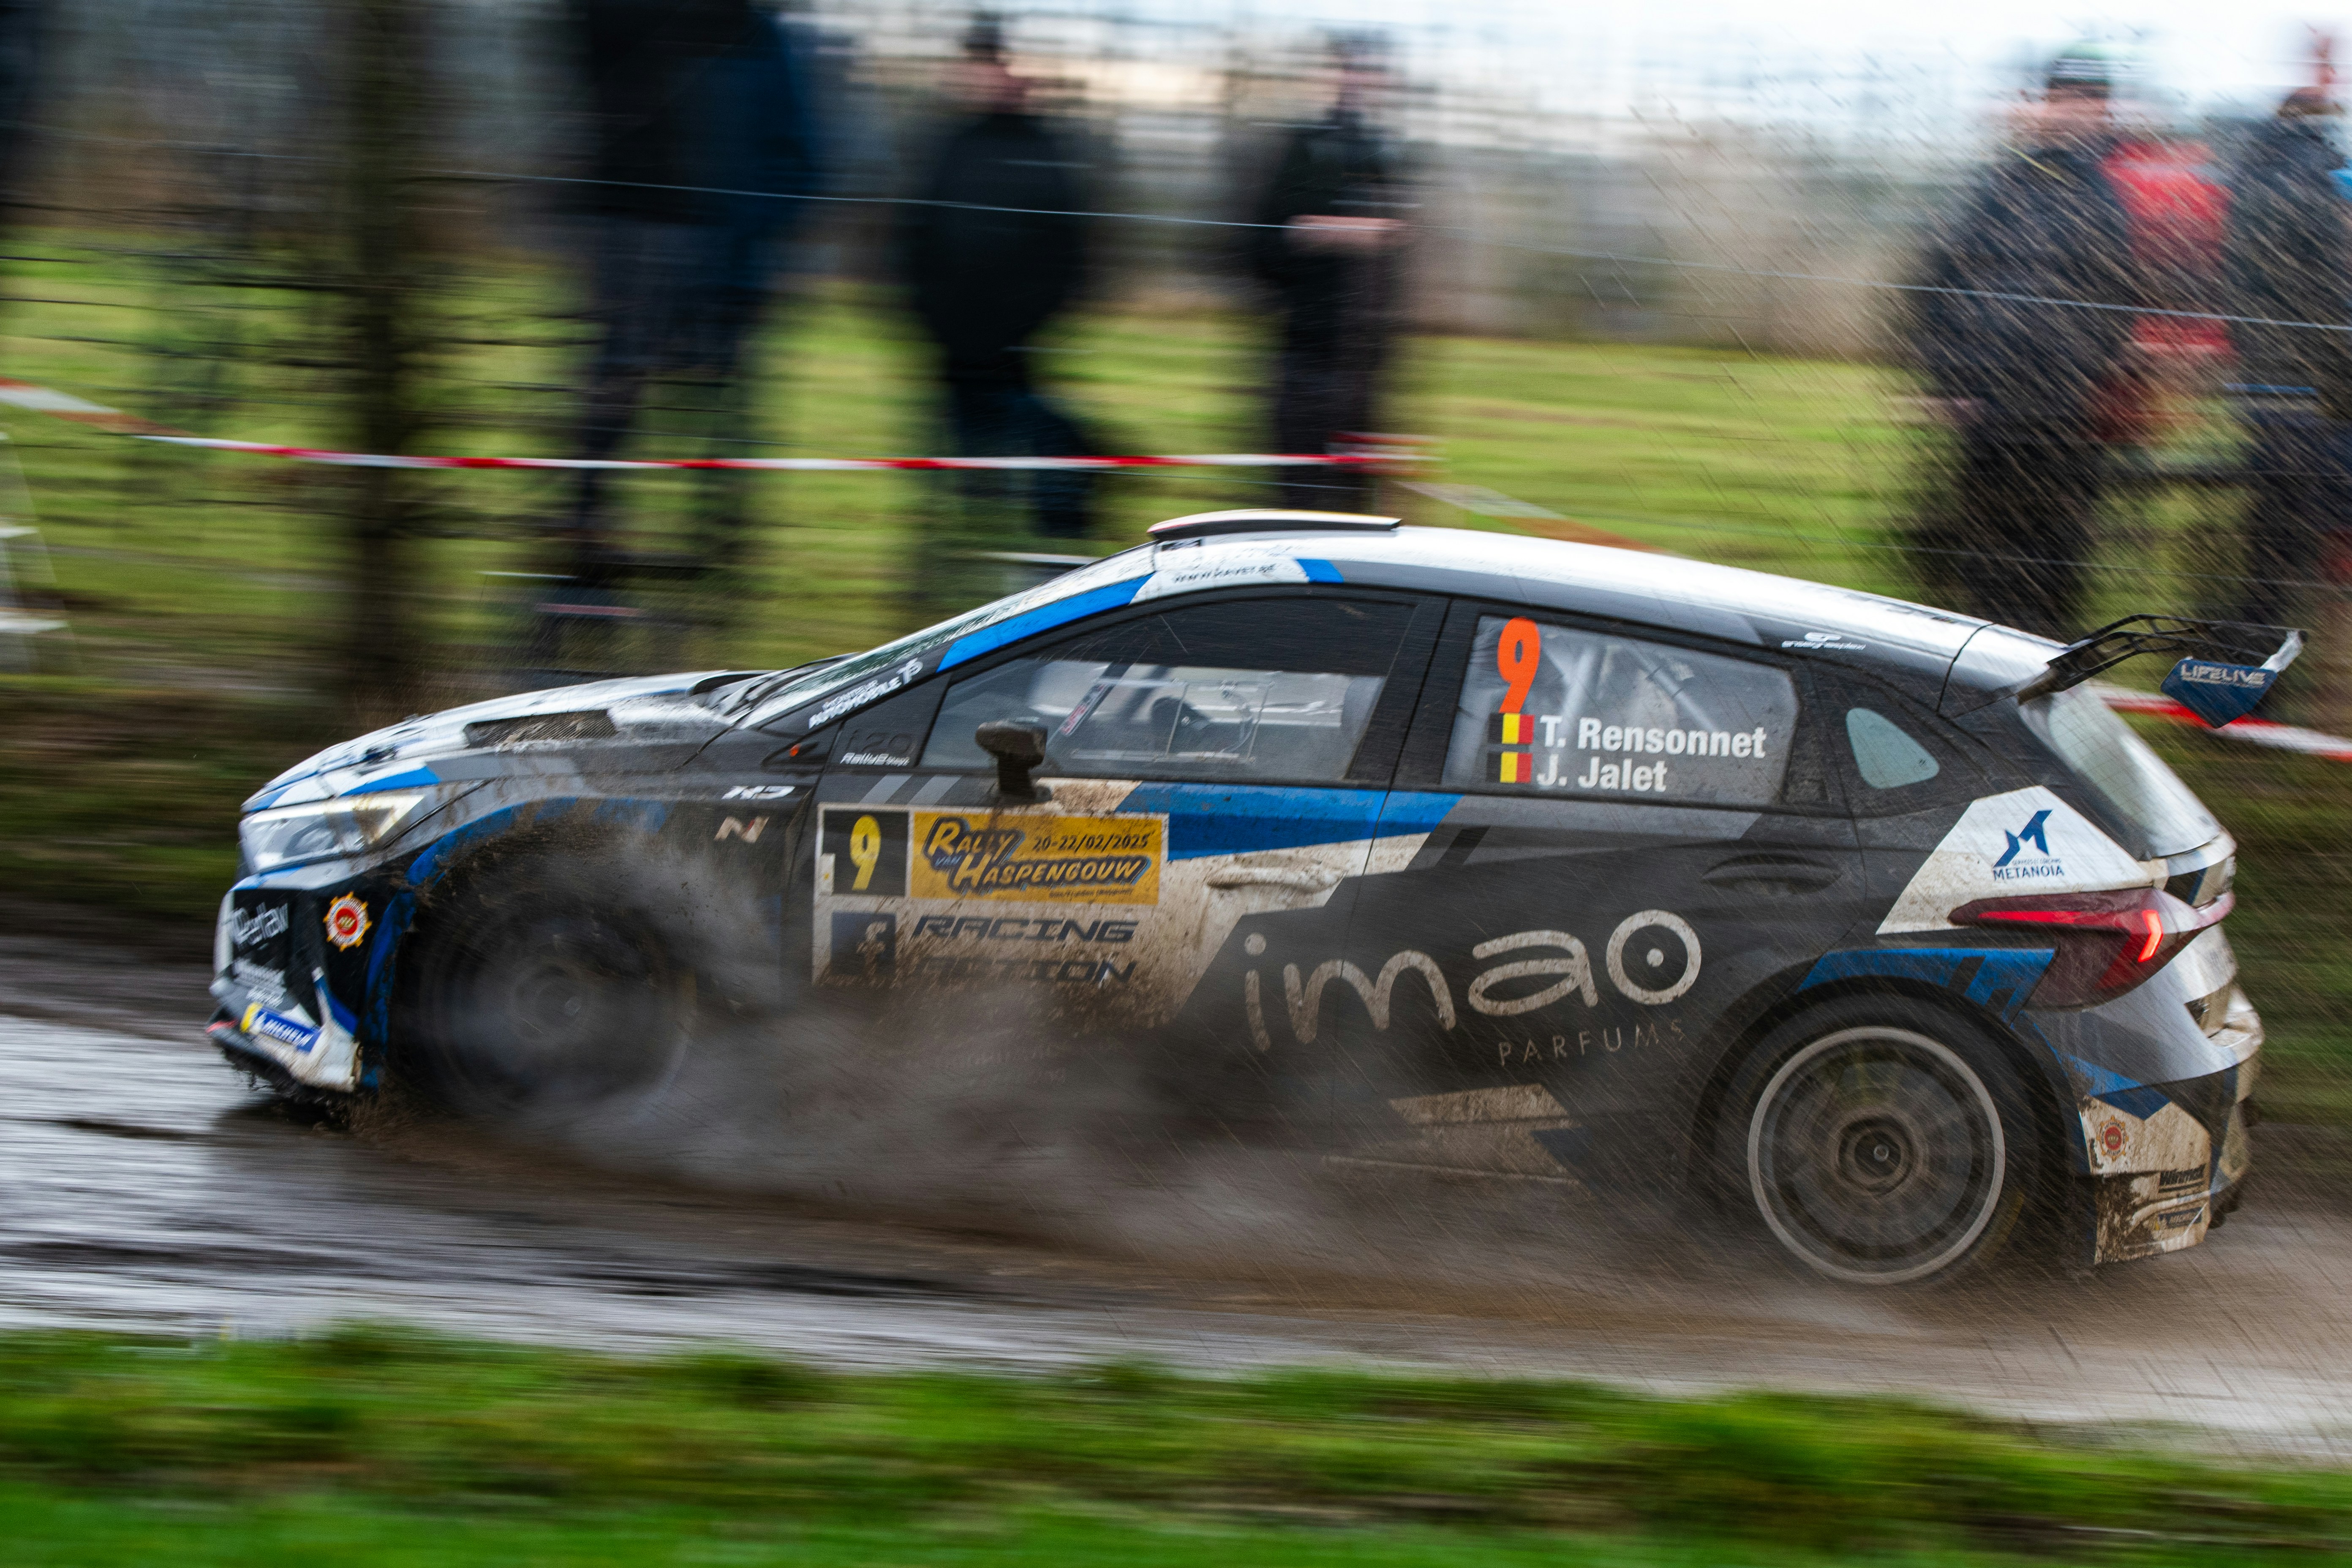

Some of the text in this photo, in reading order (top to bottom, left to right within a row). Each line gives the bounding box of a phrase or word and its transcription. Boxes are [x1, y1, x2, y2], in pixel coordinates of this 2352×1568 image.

[1497, 617, 1541, 713] 9
[1540, 716, 1767, 759] T. Rensonnet
[1537, 754, 1668, 792] J. Jalet
[849, 815, 882, 891] 9
[952, 852, 1143, 888] HASPENGOUW
[1993, 865, 2065, 881] METANOIA
[912, 915, 1140, 942] RACING
[1498, 1018, 1686, 1067] PARFUMS
